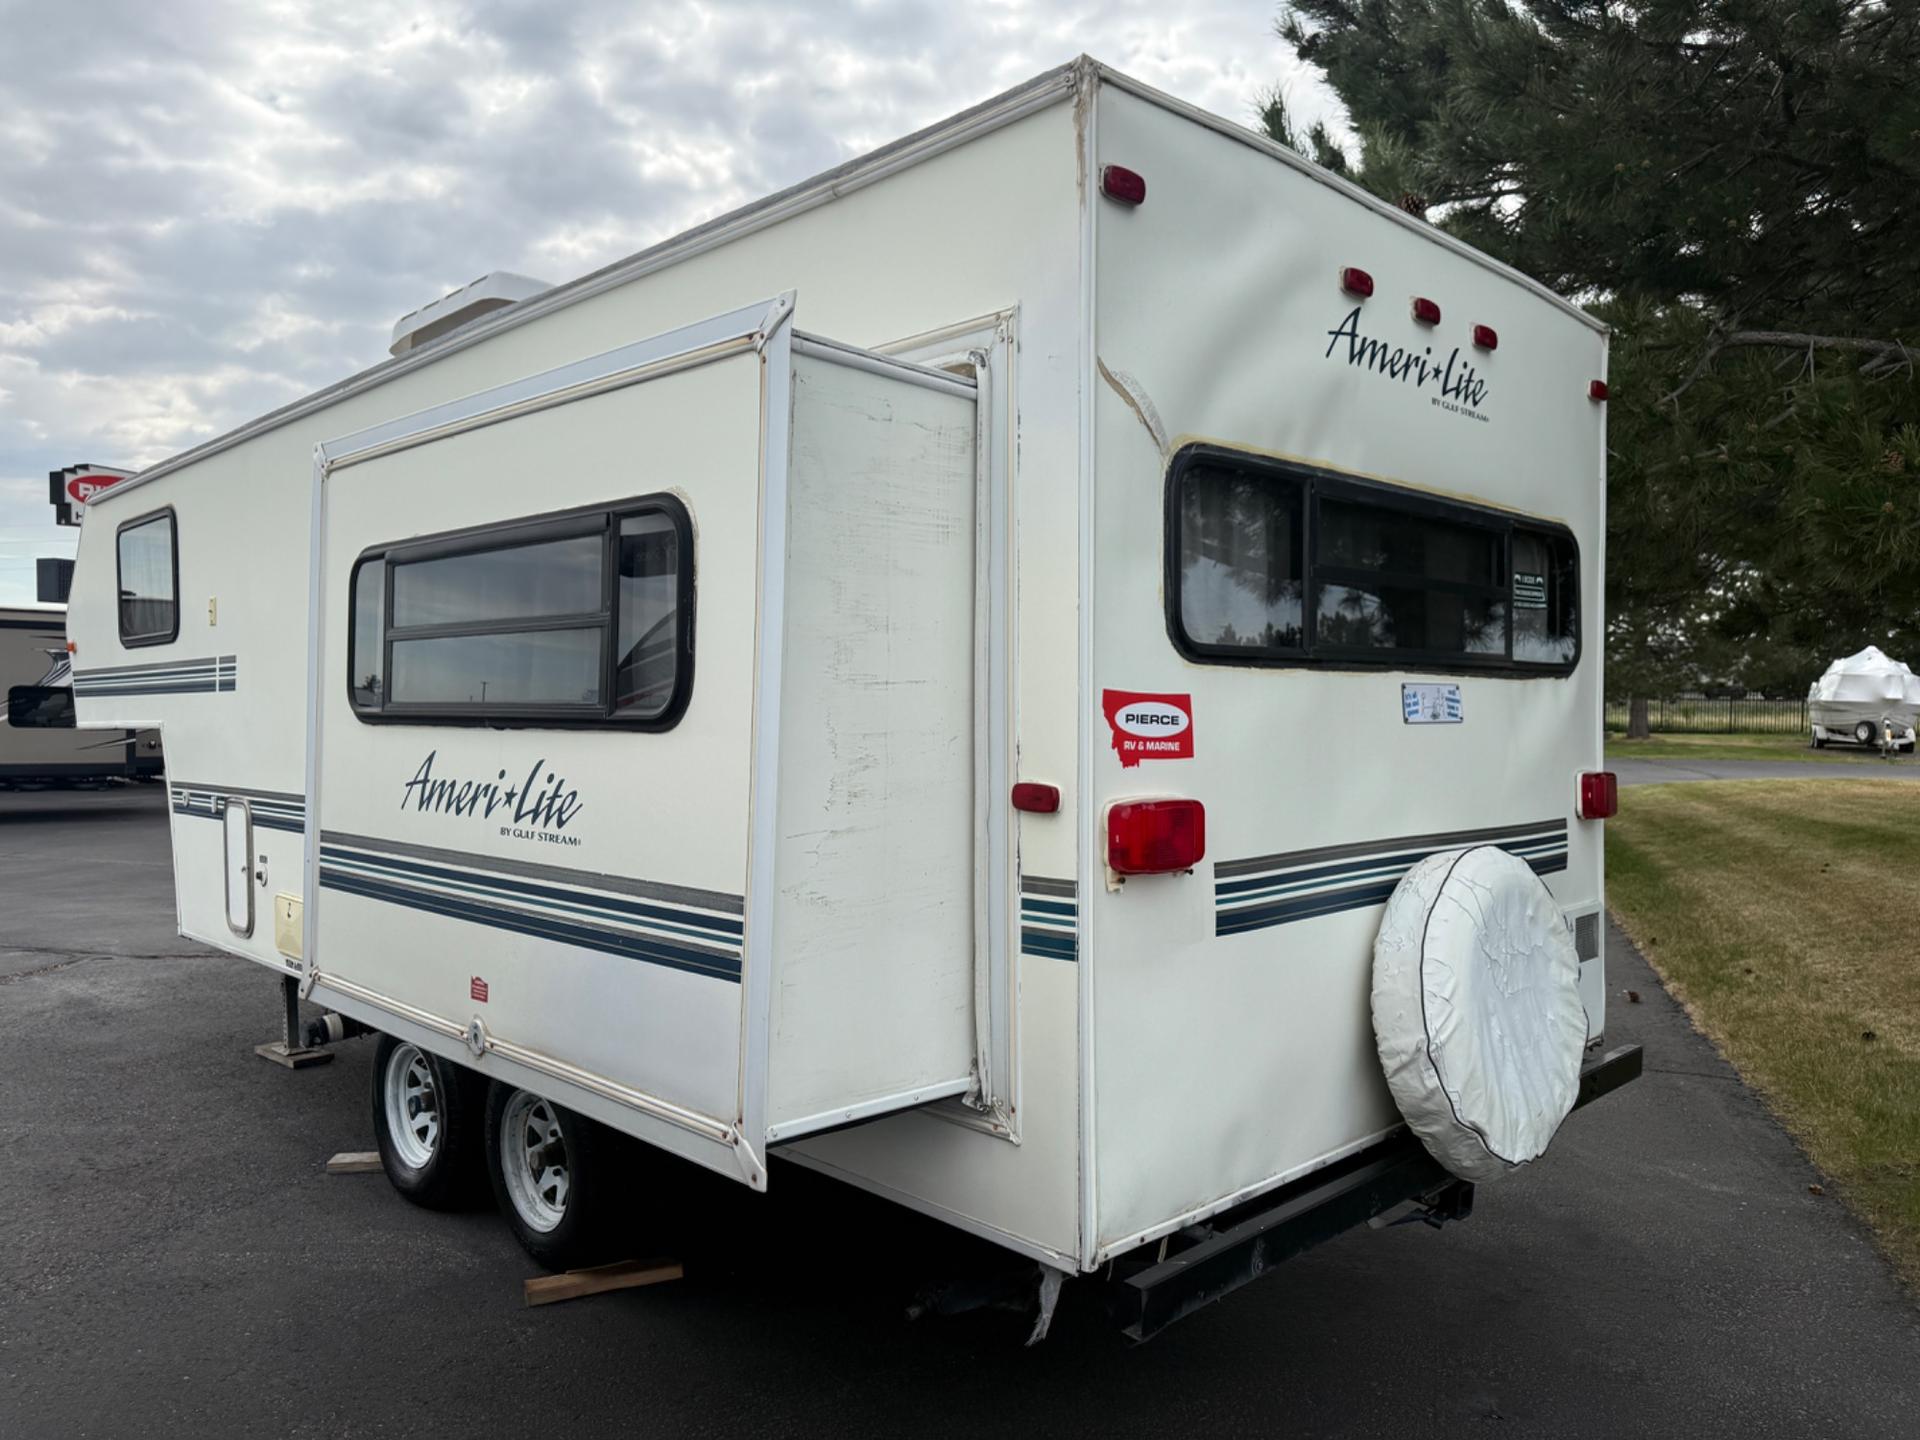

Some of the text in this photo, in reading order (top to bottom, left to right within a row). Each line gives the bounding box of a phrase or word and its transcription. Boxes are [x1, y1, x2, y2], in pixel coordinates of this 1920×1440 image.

[1431, 397, 1441, 407] BY
[1125, 713, 1180, 726] PIERCE
[1123, 740, 1180, 752] RV & MARINE
[500, 826, 578, 847] BY GULF STREAM
